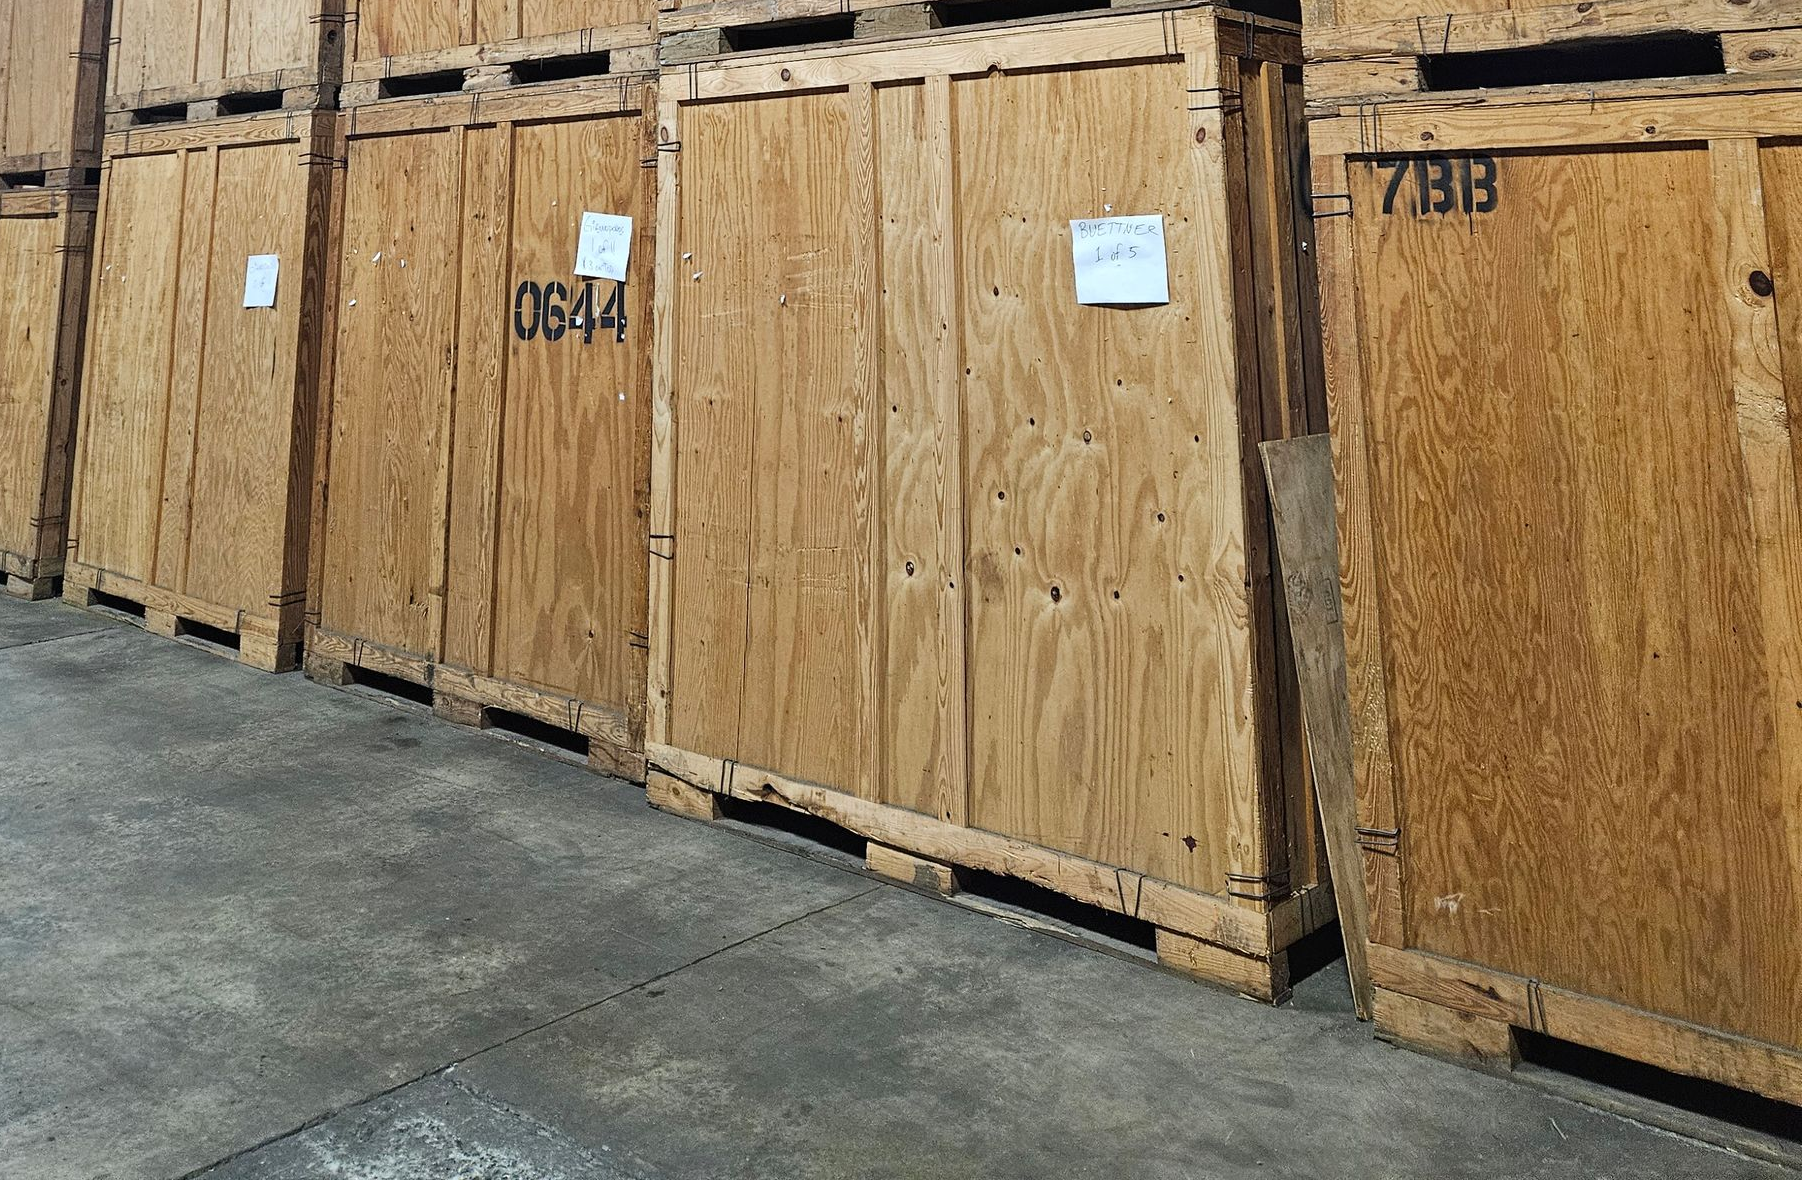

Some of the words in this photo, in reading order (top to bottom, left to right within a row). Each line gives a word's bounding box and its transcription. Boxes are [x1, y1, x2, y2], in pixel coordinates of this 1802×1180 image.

[1377, 155, 1498, 216] 7BB
[1078, 221, 1159, 239] BUETTNER
[1094, 246, 1104, 263] 1
[1110, 242, 1123, 262] of
[1128, 245, 1141, 259] 5
[514, 280, 627, 344] 0644
